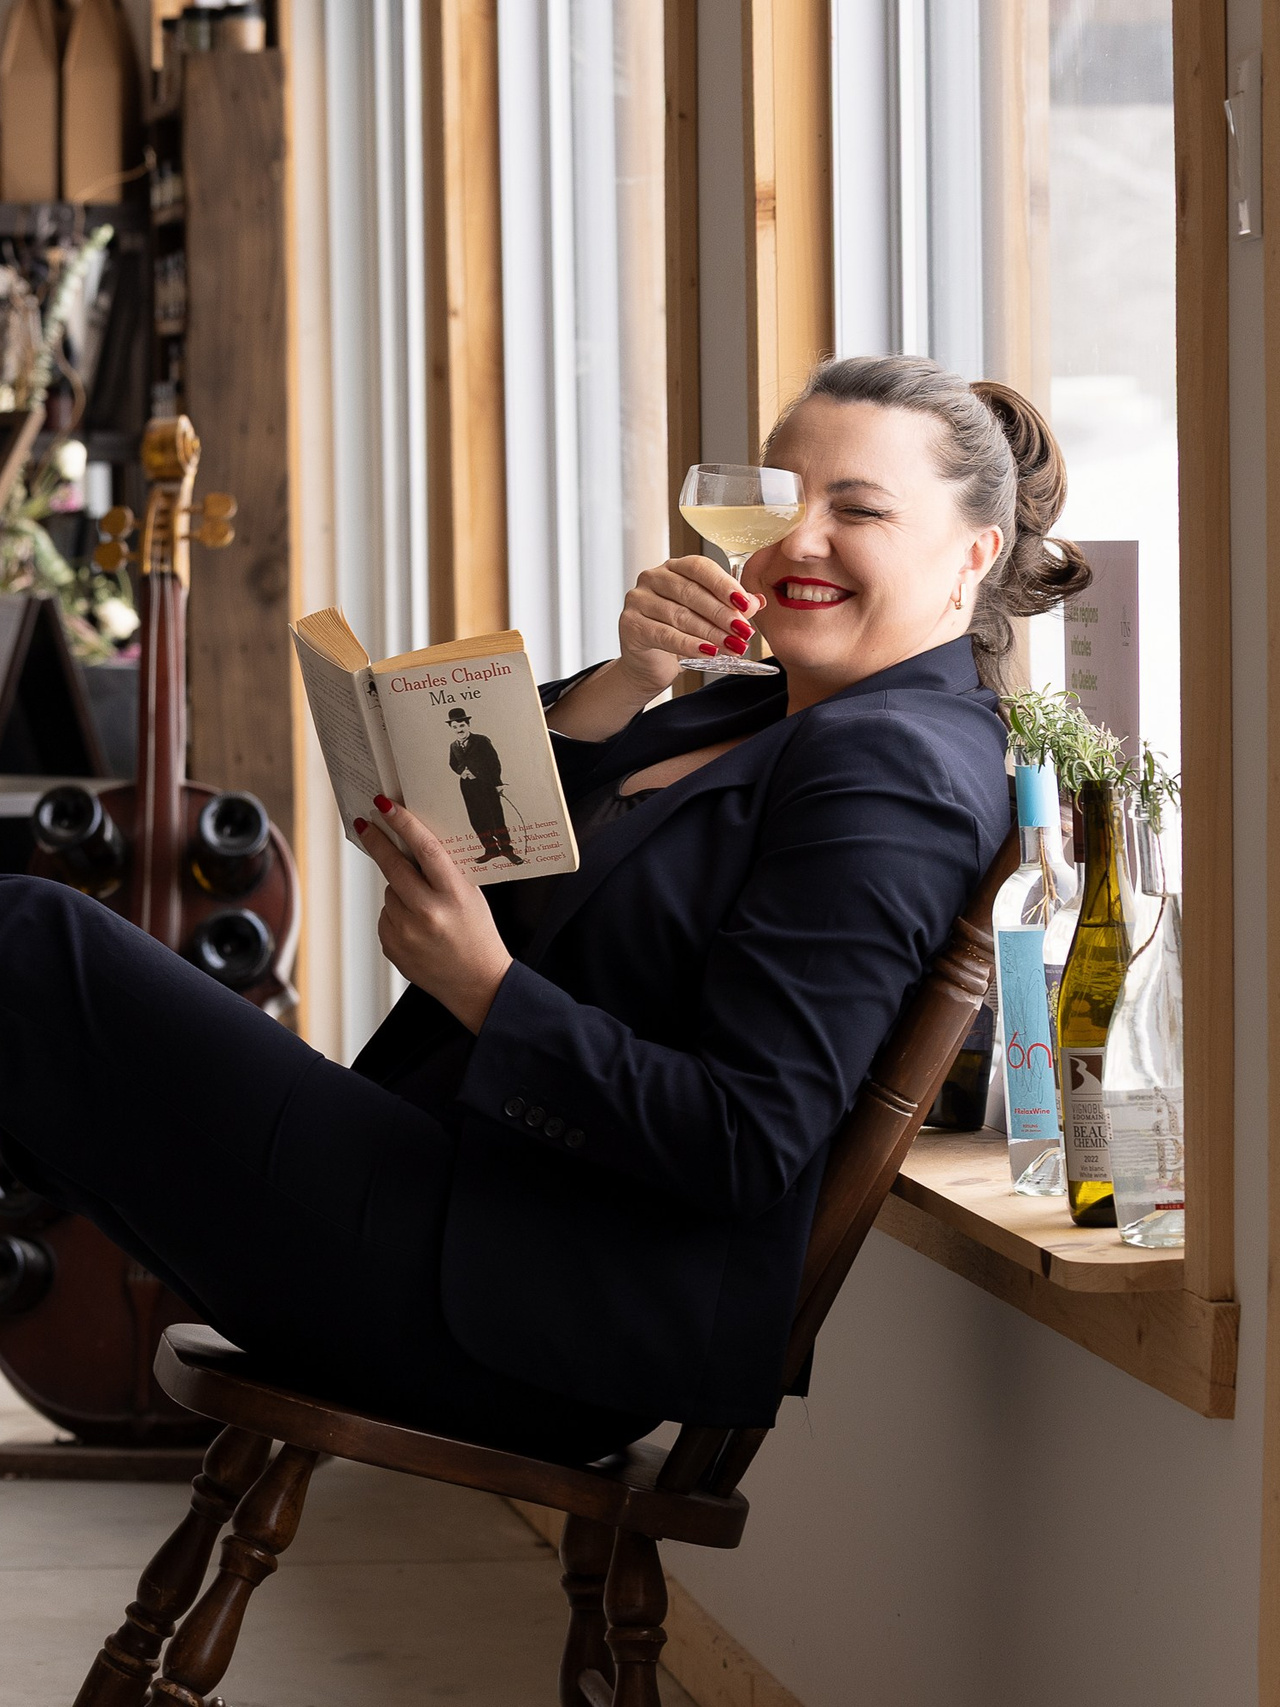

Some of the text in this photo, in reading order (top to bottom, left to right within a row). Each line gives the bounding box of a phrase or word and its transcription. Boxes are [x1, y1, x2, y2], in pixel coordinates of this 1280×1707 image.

[390, 662, 512, 693] Charles Chaplin
[1079, 669, 1098, 691] Québec
[428, 686, 482, 706] Ma vie
[455, 834, 463, 842] le
[464, 833, 474, 841] 16
[535, 820, 558, 829] heures
[452, 846, 465, 854] soir
[466, 843, 483, 852] dans
[1072, 1103, 1103, 1114] VIGNOBL
[1073, 1125, 1108, 1138] BEAU
[1073, 1138, 1109, 1148] CHEMIN
